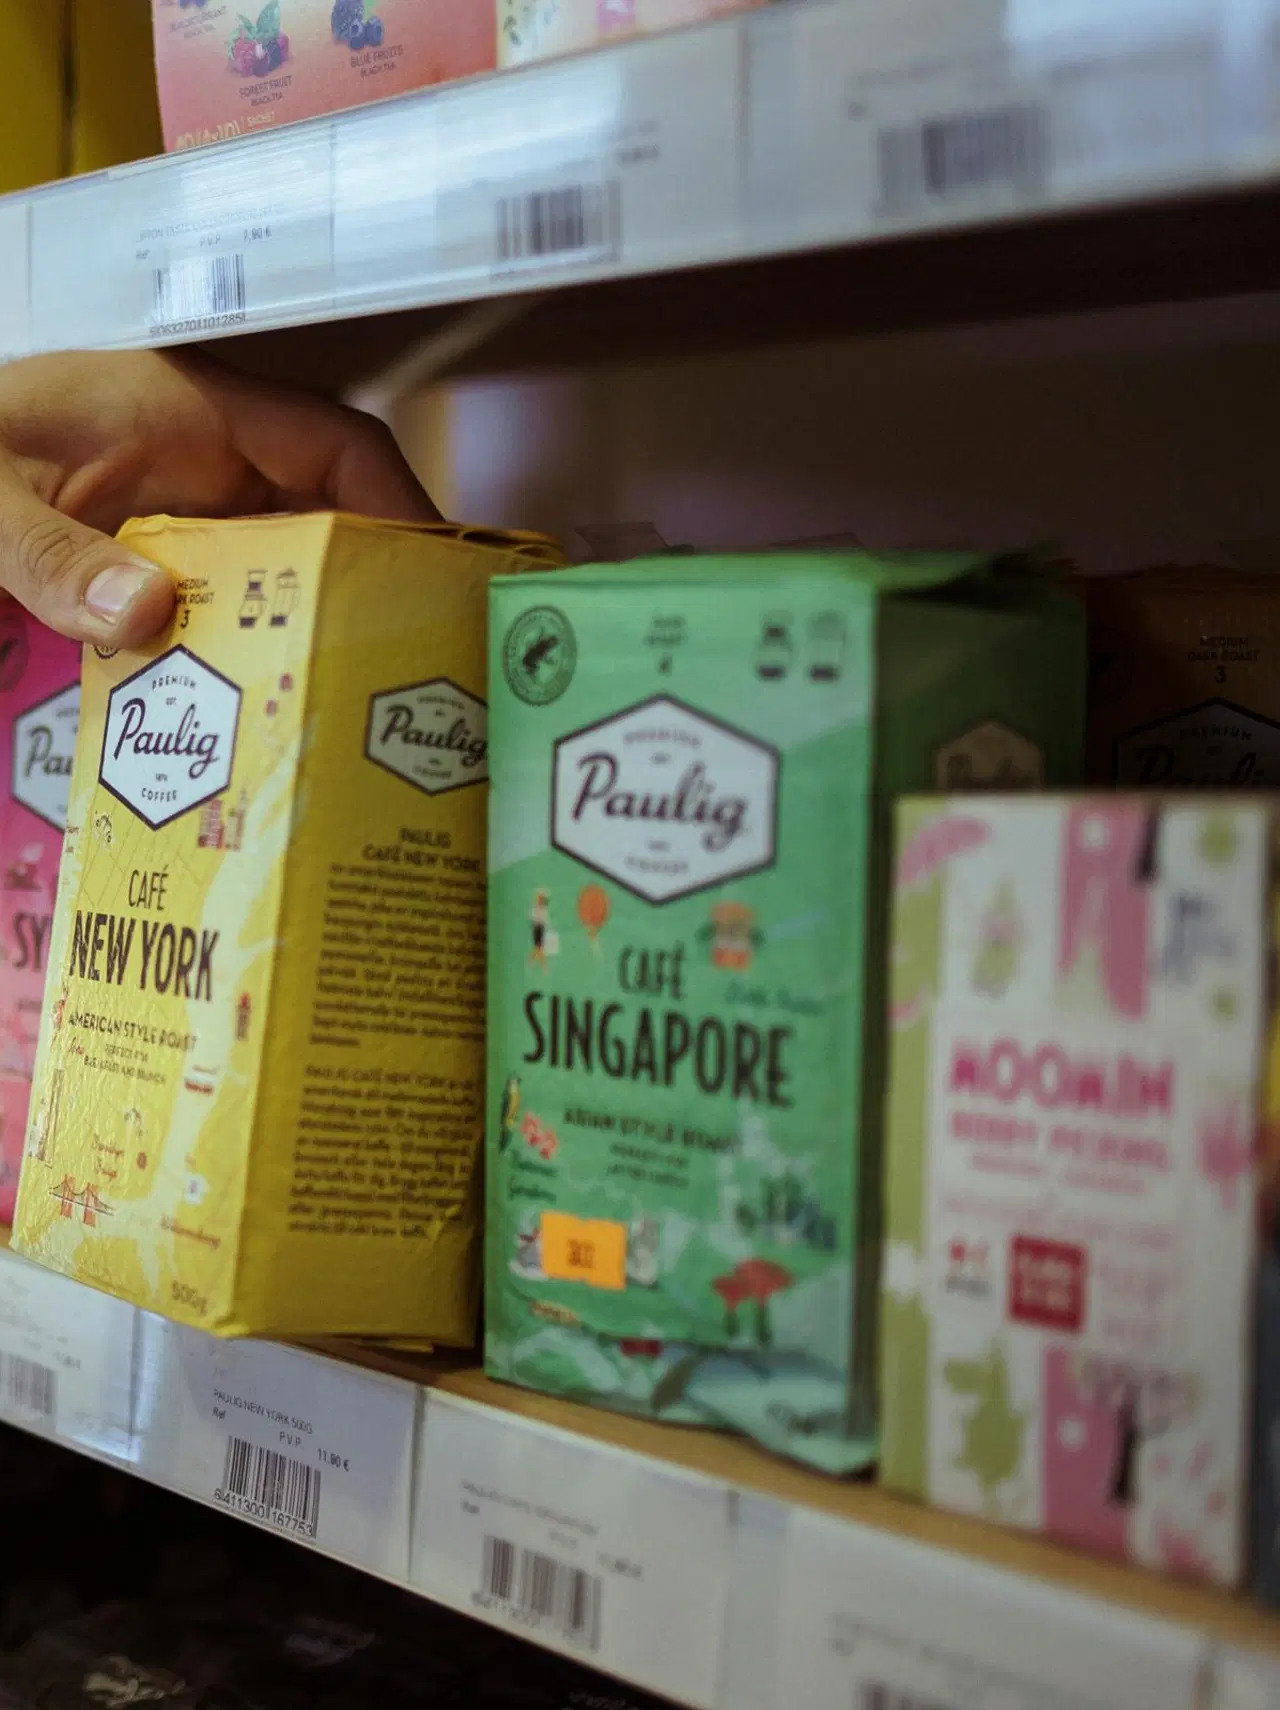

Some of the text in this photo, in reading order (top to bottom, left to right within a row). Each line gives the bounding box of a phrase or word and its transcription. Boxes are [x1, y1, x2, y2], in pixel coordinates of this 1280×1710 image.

[180, 609, 192, 629] 3
[113, 697, 221, 780] Paulig
[141, 787, 178, 802] COFFEE
[571, 752, 748, 853] Paulig
[128, 864, 169, 911] CAFÉ
[69, 909, 136, 986] NEW
[140, 920, 220, 1002] YORK
[618, 940, 686, 999] CAFÉ
[68, 1009, 197, 1053] AMERICAN STYLE ROAST
[522, 991, 794, 1109] SINGAPORE
[213, 1389, 243, 1408] PAULIG
[243, 1400, 265, 1416] NEW
[265, 1410, 290, 1426] YORK
